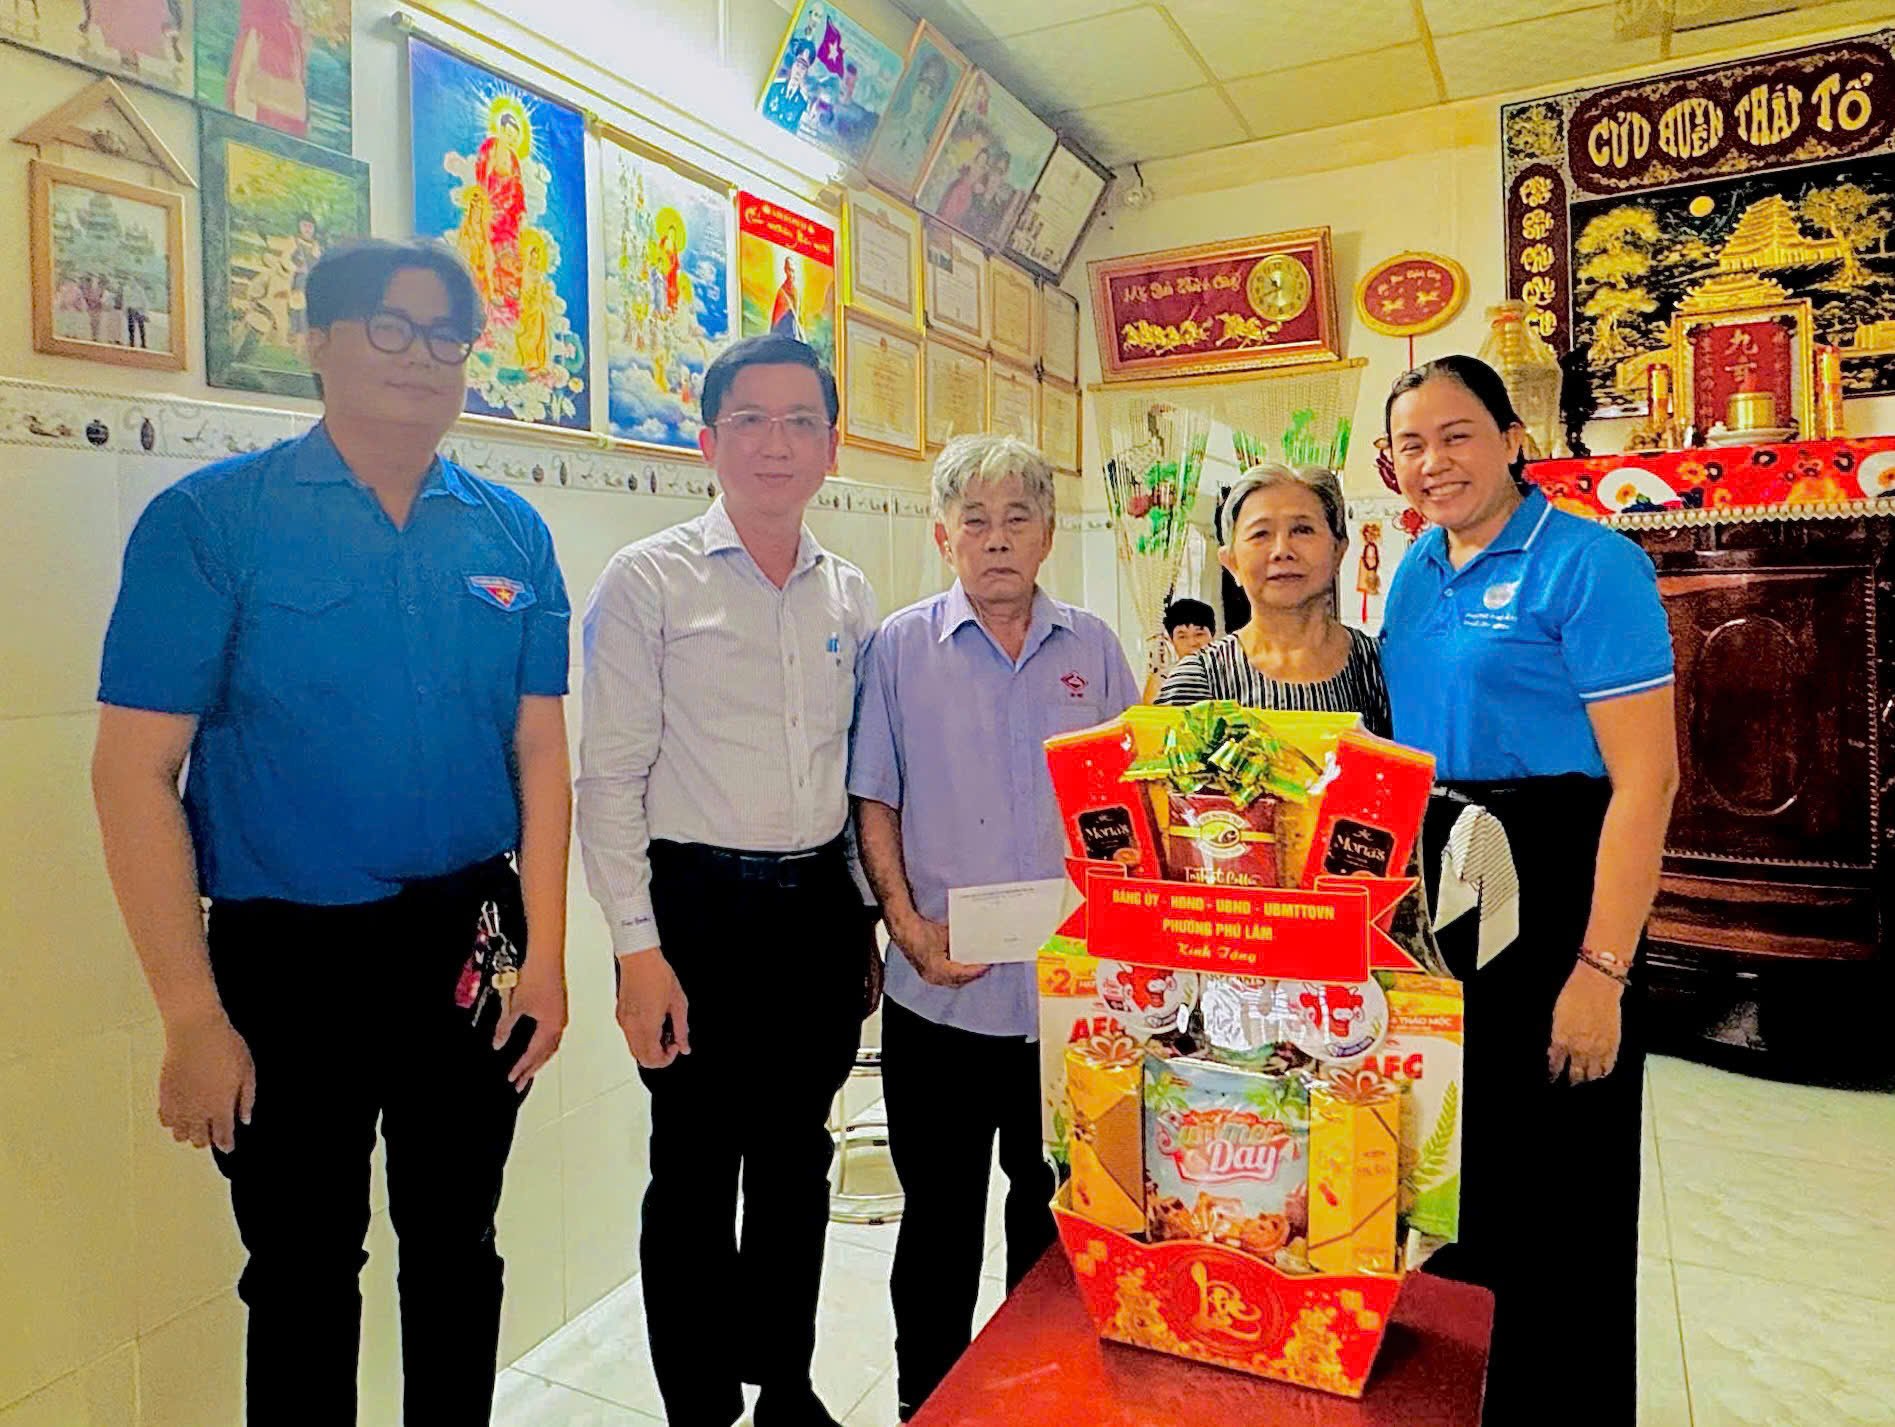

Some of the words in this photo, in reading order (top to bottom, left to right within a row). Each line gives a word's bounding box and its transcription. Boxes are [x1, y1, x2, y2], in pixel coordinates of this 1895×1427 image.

[1812, 72, 1873, 132] TỔ
[1215, 898, 1251, 915] UBND
[1208, 1139, 1279, 1180] Day
